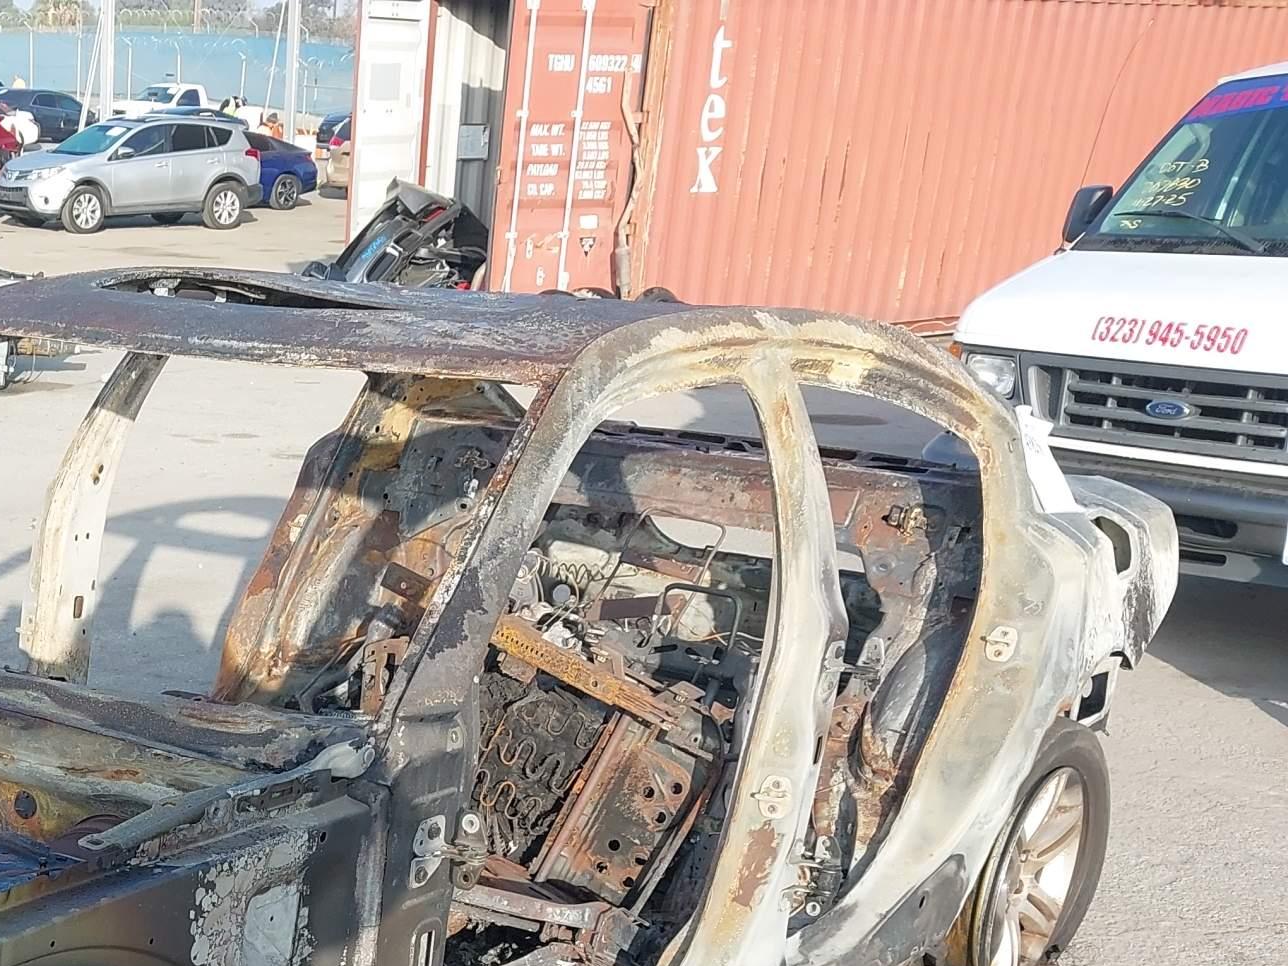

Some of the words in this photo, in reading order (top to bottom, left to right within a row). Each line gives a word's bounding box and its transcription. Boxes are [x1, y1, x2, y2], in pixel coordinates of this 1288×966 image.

[1091, 316, 1146, 344] (323)
[1145, 319, 1249, 355] 945-5950
[1155, 404, 1178, 415] Ford
